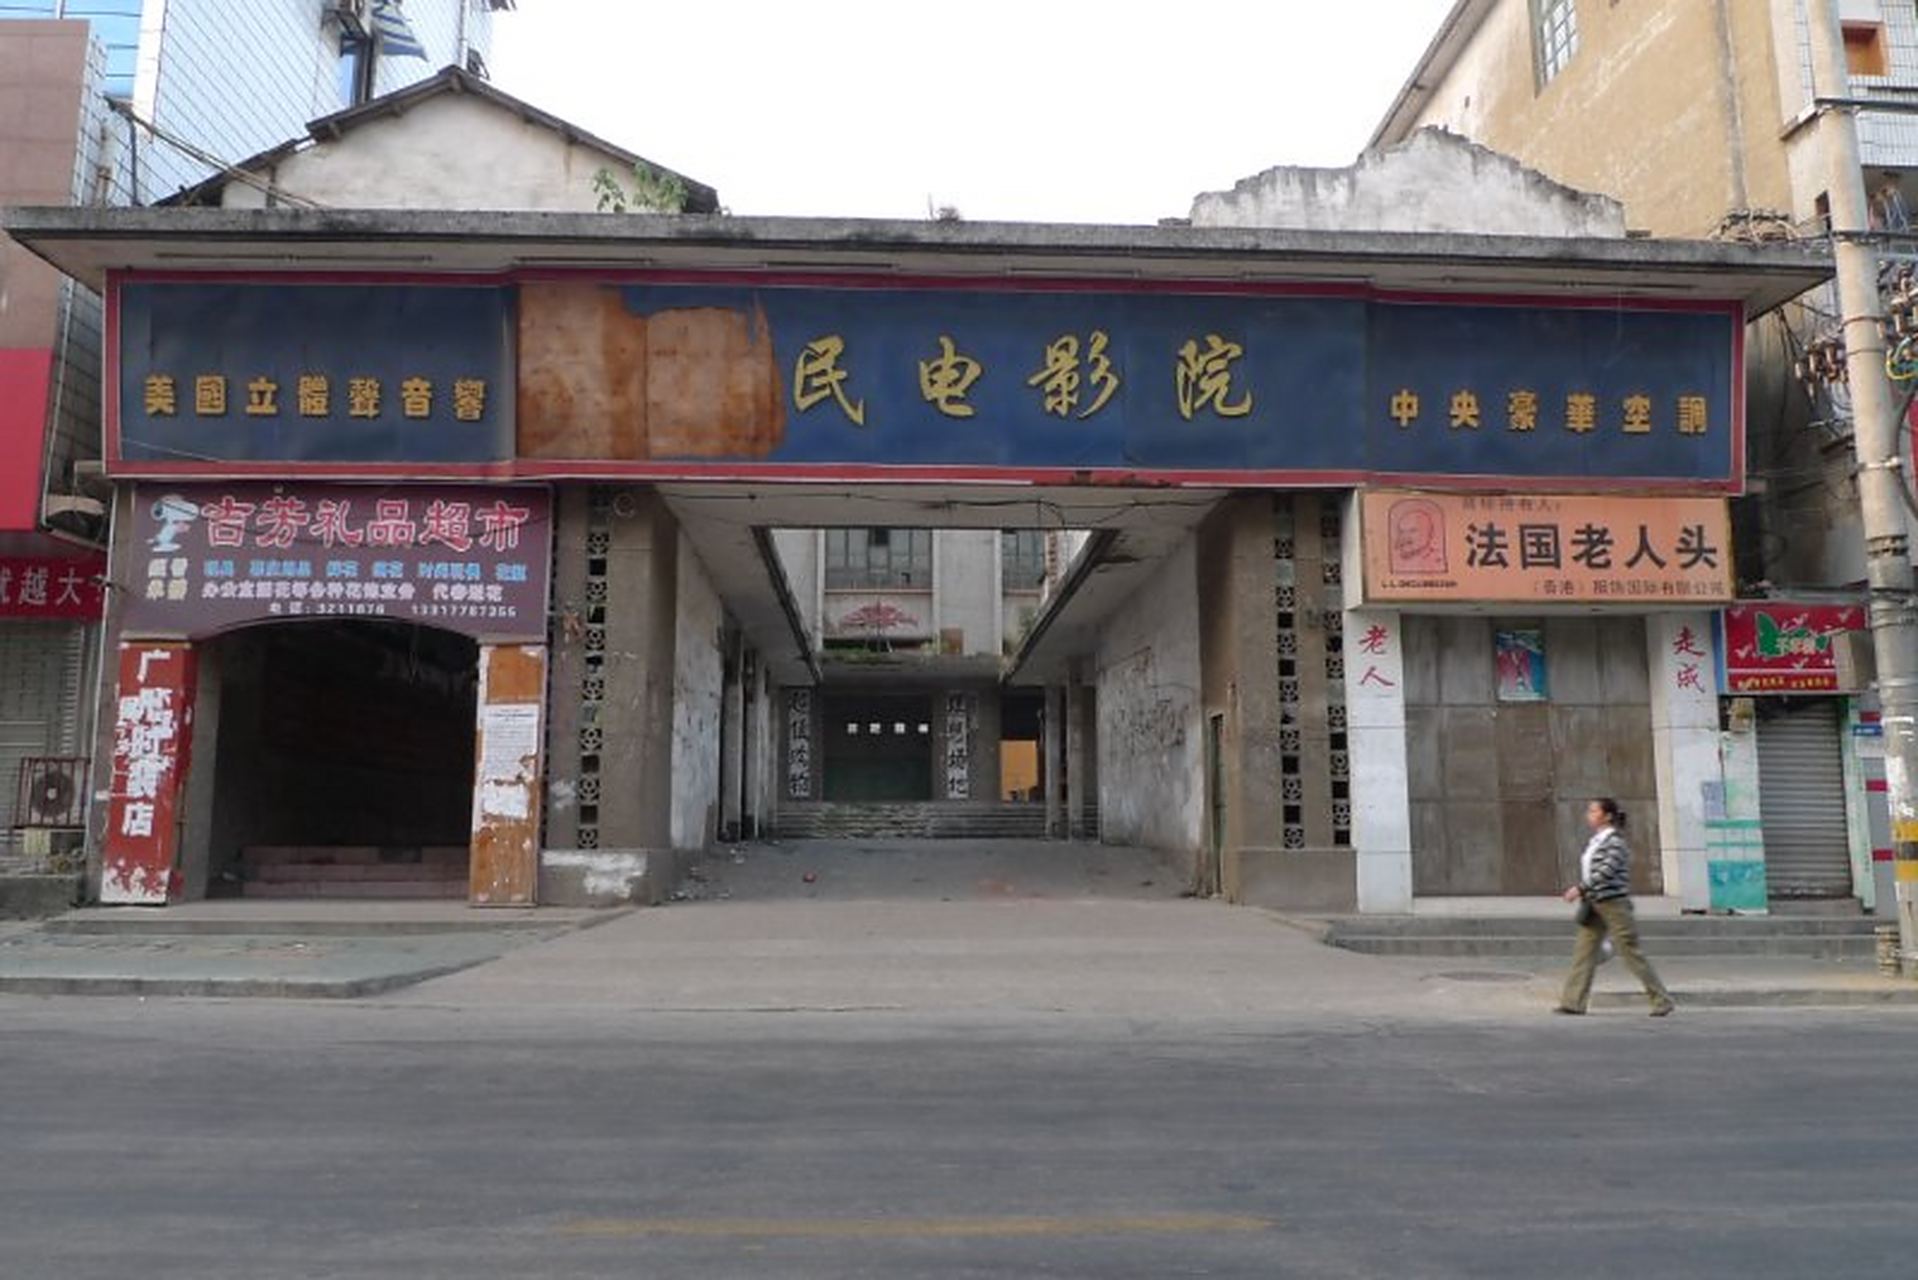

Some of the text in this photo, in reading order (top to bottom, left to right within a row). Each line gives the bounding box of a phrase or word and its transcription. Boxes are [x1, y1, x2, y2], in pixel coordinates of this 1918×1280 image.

[793, 330, 1252, 425] 民电影院
[1391, 389, 1707, 434] 中央豪華空調
[202, 496, 530, 552] 吉芳礼品超市
[1465, 523, 1717, 570] 法国老人头
[1359, 625, 1395, 686] 老人
